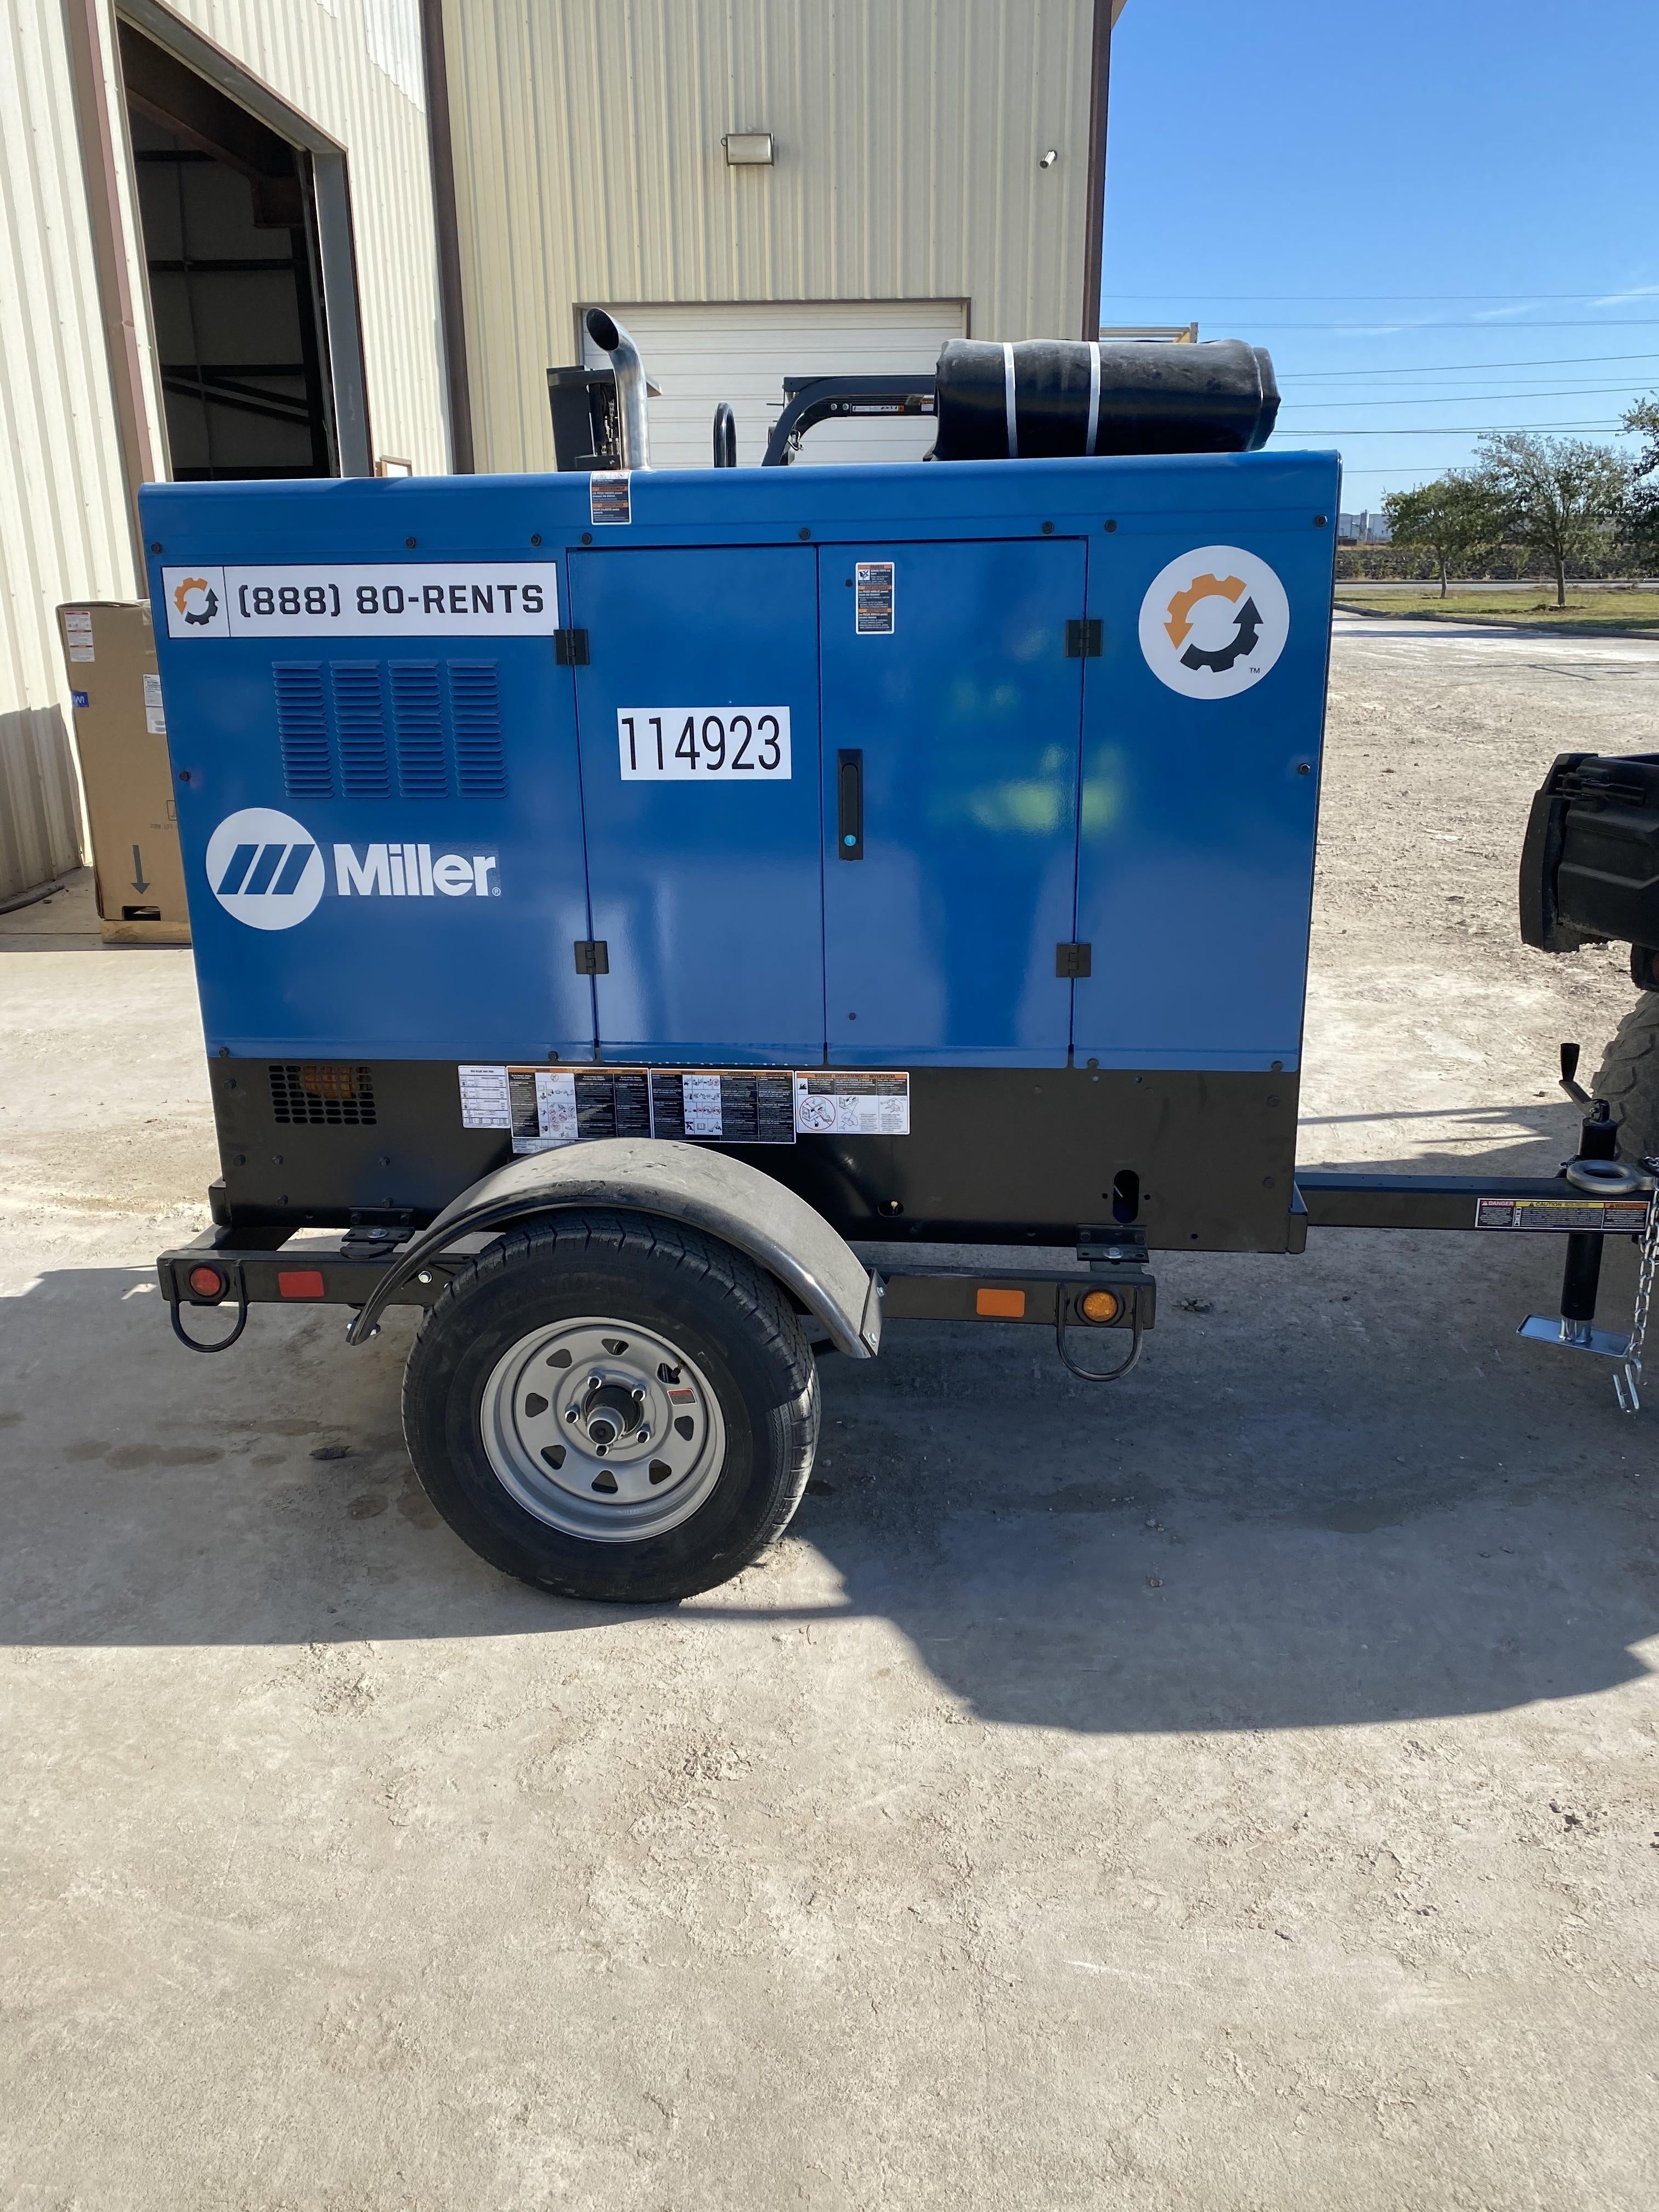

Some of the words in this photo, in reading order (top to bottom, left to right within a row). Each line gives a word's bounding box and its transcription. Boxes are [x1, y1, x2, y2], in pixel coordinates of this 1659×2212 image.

[239, 584, 340, 618] (888)
[356, 584, 544, 614] 80-RENTS
[621, 715, 781, 770] 114923
